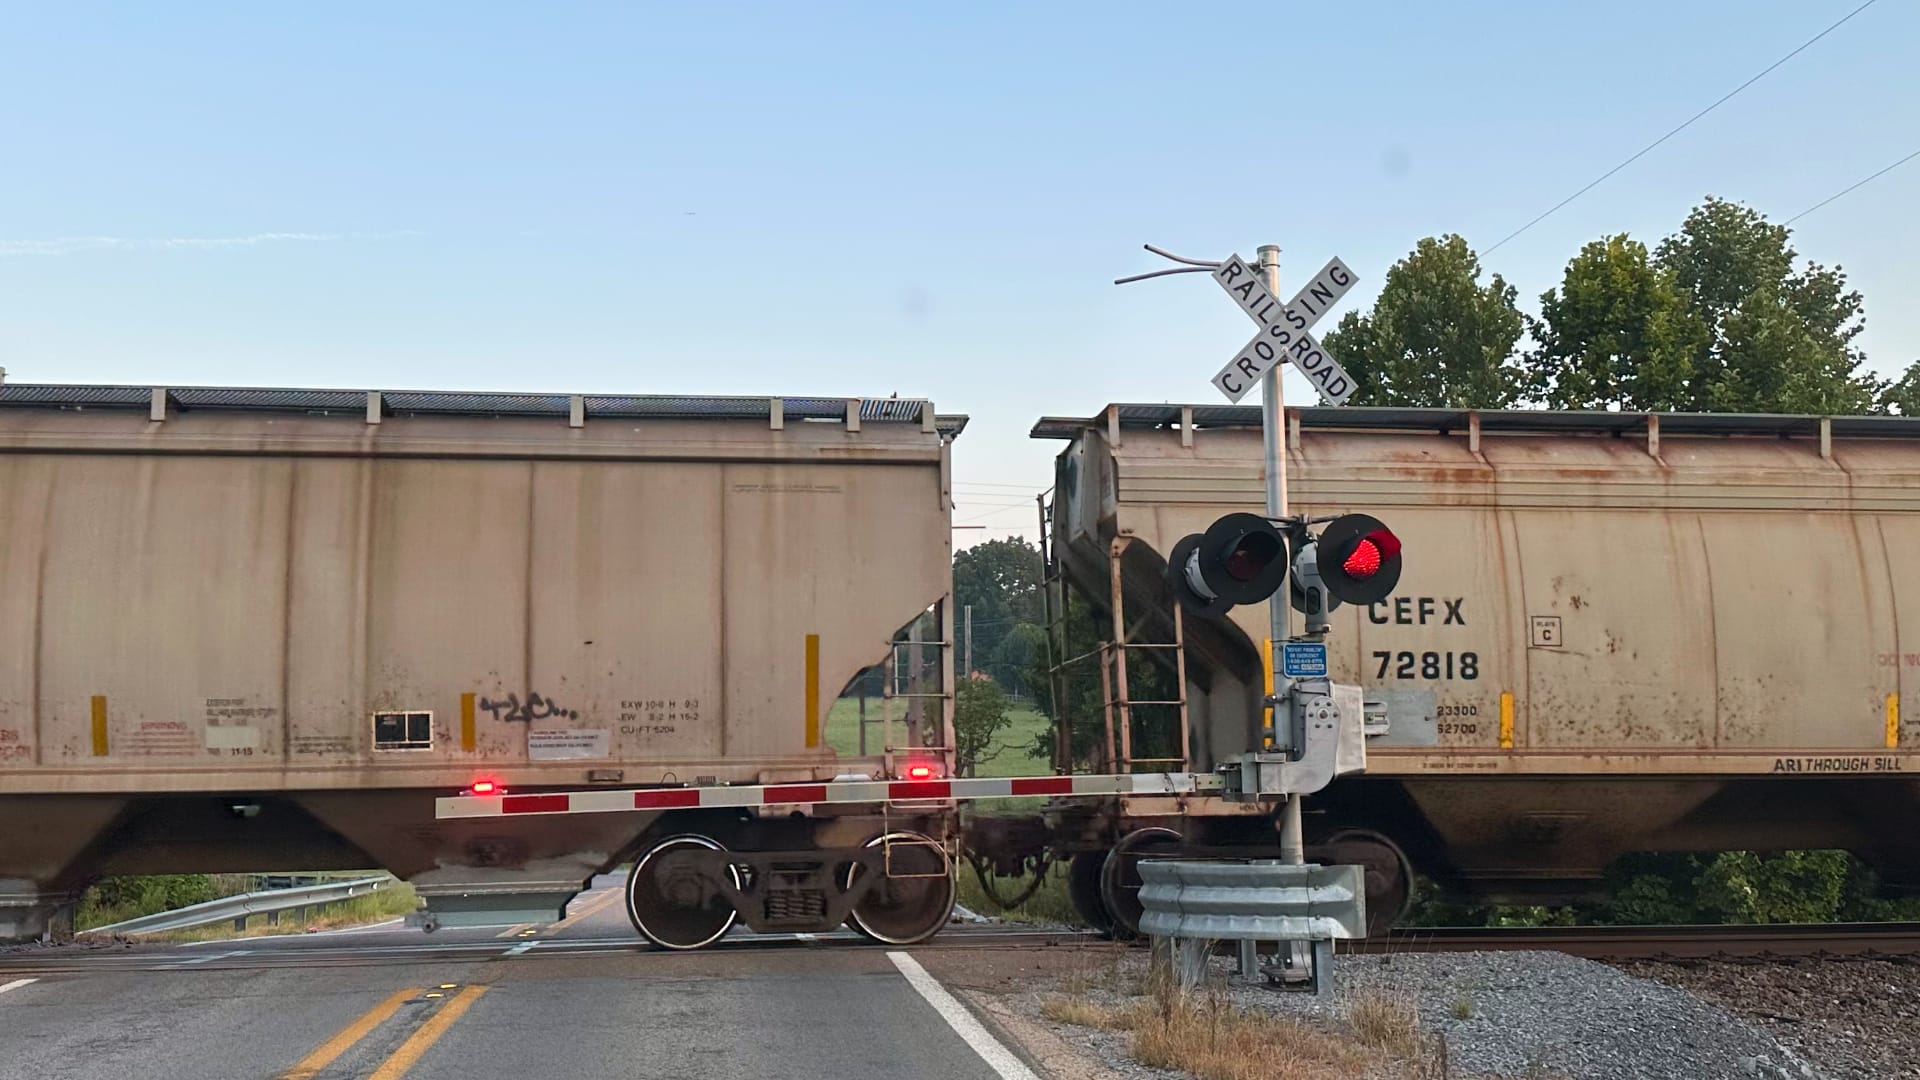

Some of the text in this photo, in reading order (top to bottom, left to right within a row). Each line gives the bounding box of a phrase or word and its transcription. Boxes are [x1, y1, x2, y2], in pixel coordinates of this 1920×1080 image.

[1221, 261, 1347, 397] RAIL ROAD
[1222, 266, 1349, 394] CROSSING
[1369, 598, 1466, 625] CEFX
[1542, 629, 1552, 641] C
[1373, 651, 1479, 680] 72818
[1774, 758, 1902, 772] ARI THROUGH SILL
